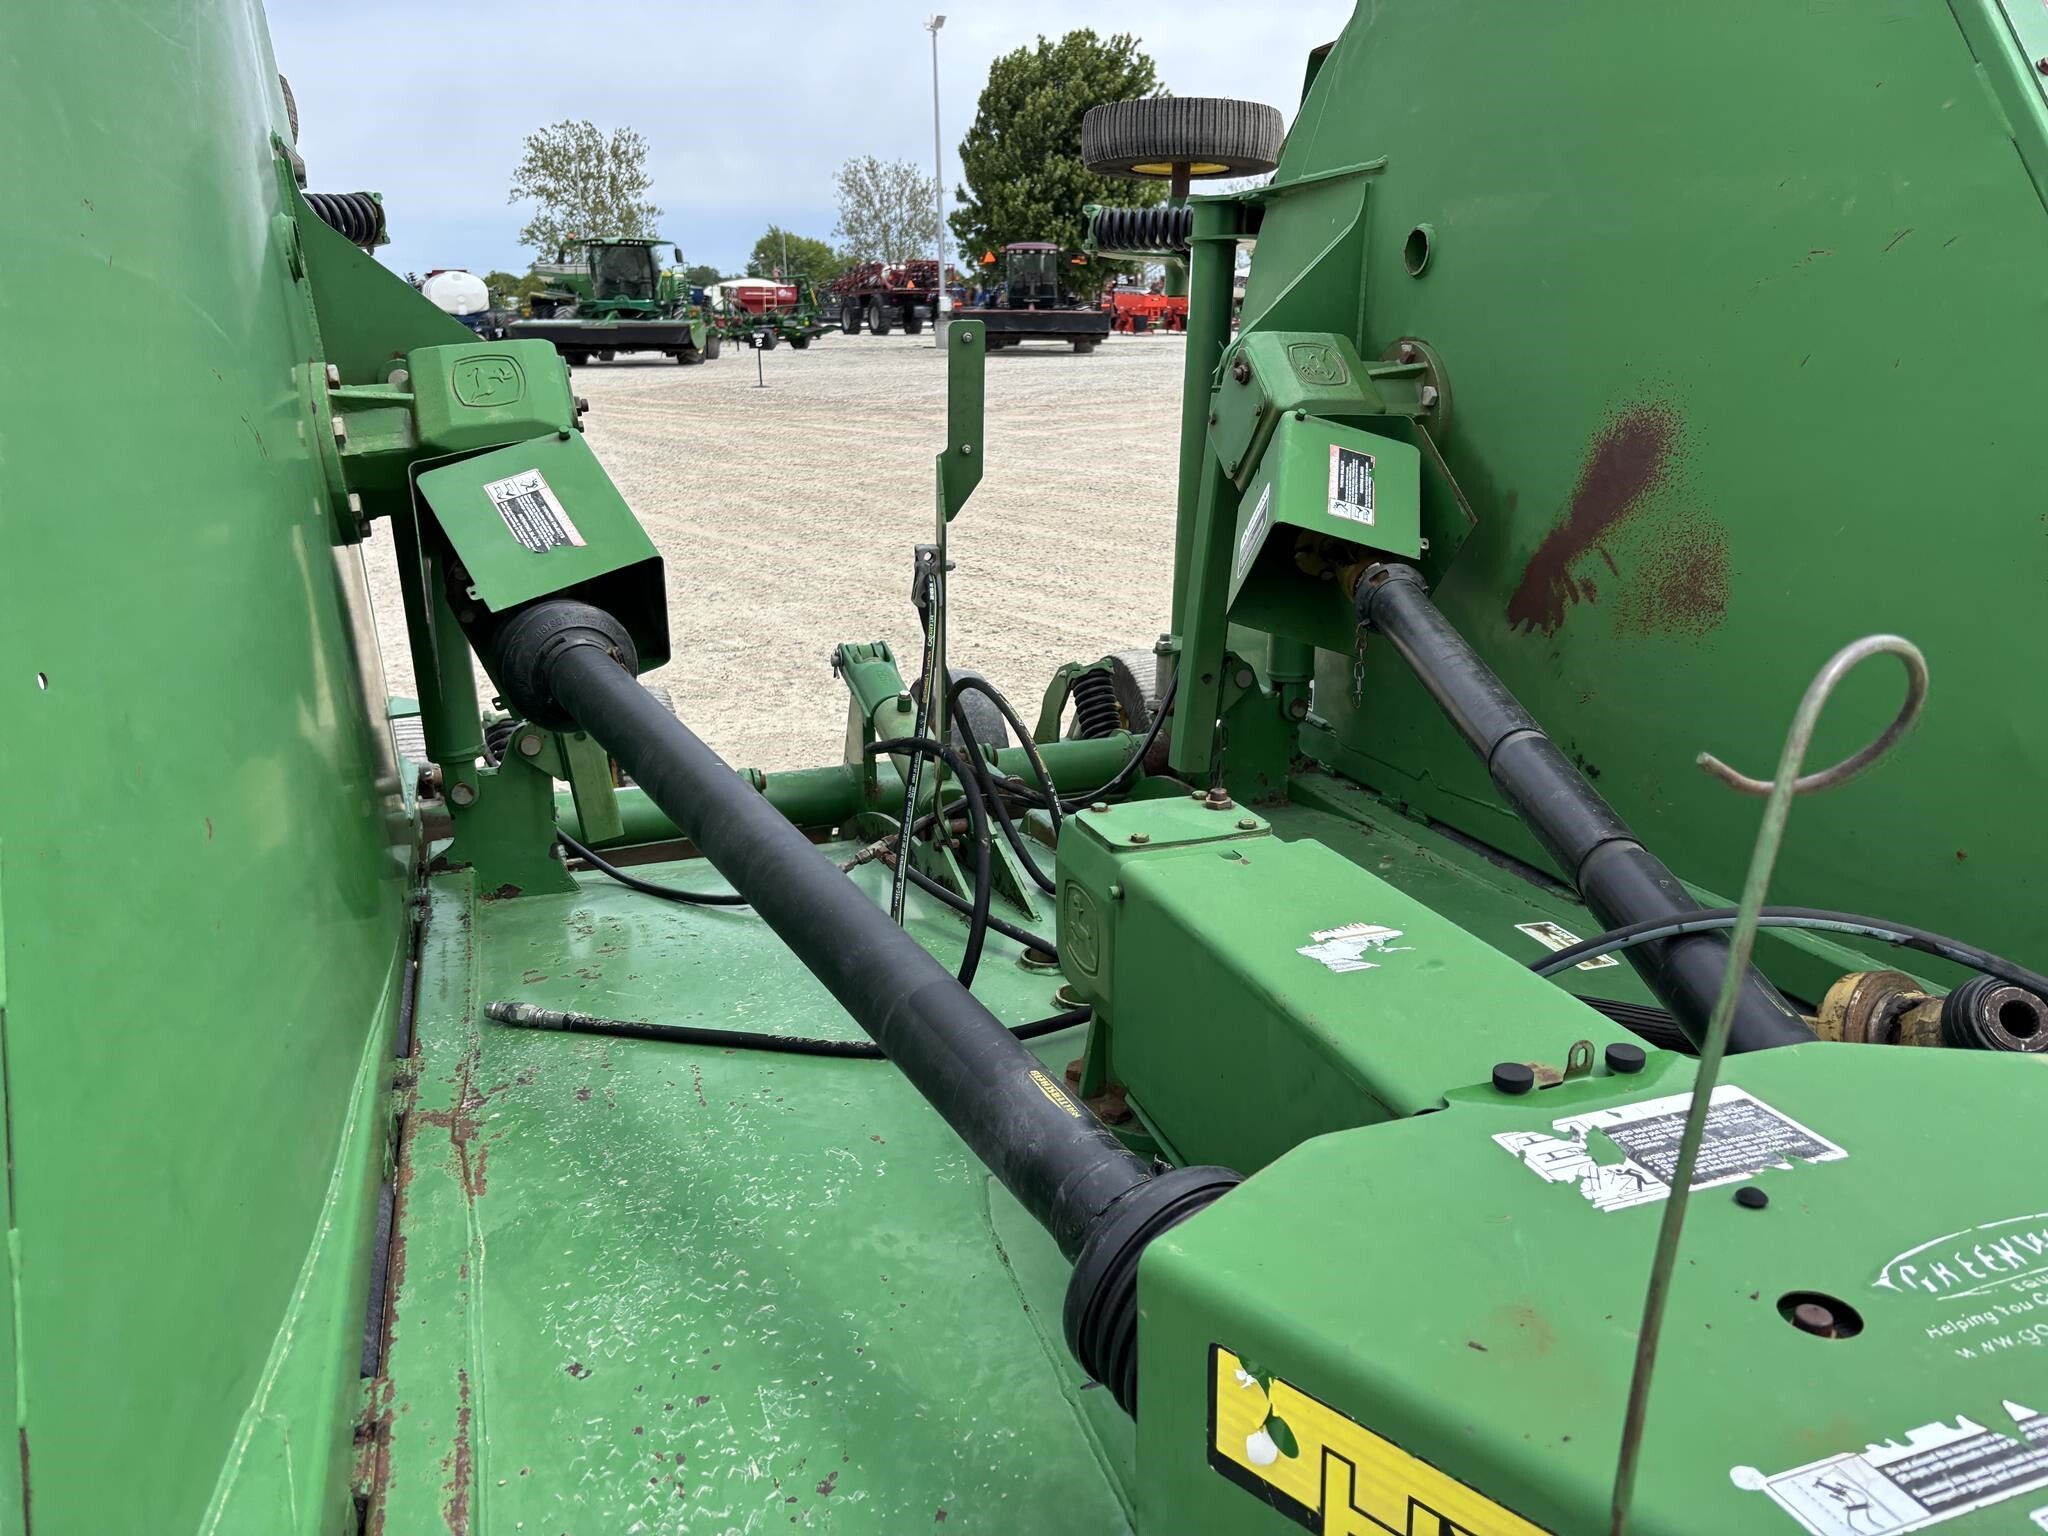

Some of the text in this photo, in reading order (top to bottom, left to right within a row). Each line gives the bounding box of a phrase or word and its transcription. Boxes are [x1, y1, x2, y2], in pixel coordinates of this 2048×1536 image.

[755, 338, 763, 347] 2
[1642, 1153, 1666, 1161] AVOID
[1720, 1134, 1756, 1144] THROWN
[1926, 1311, 1999, 1339] Helping
[1993, 1300, 2034, 1316] You
